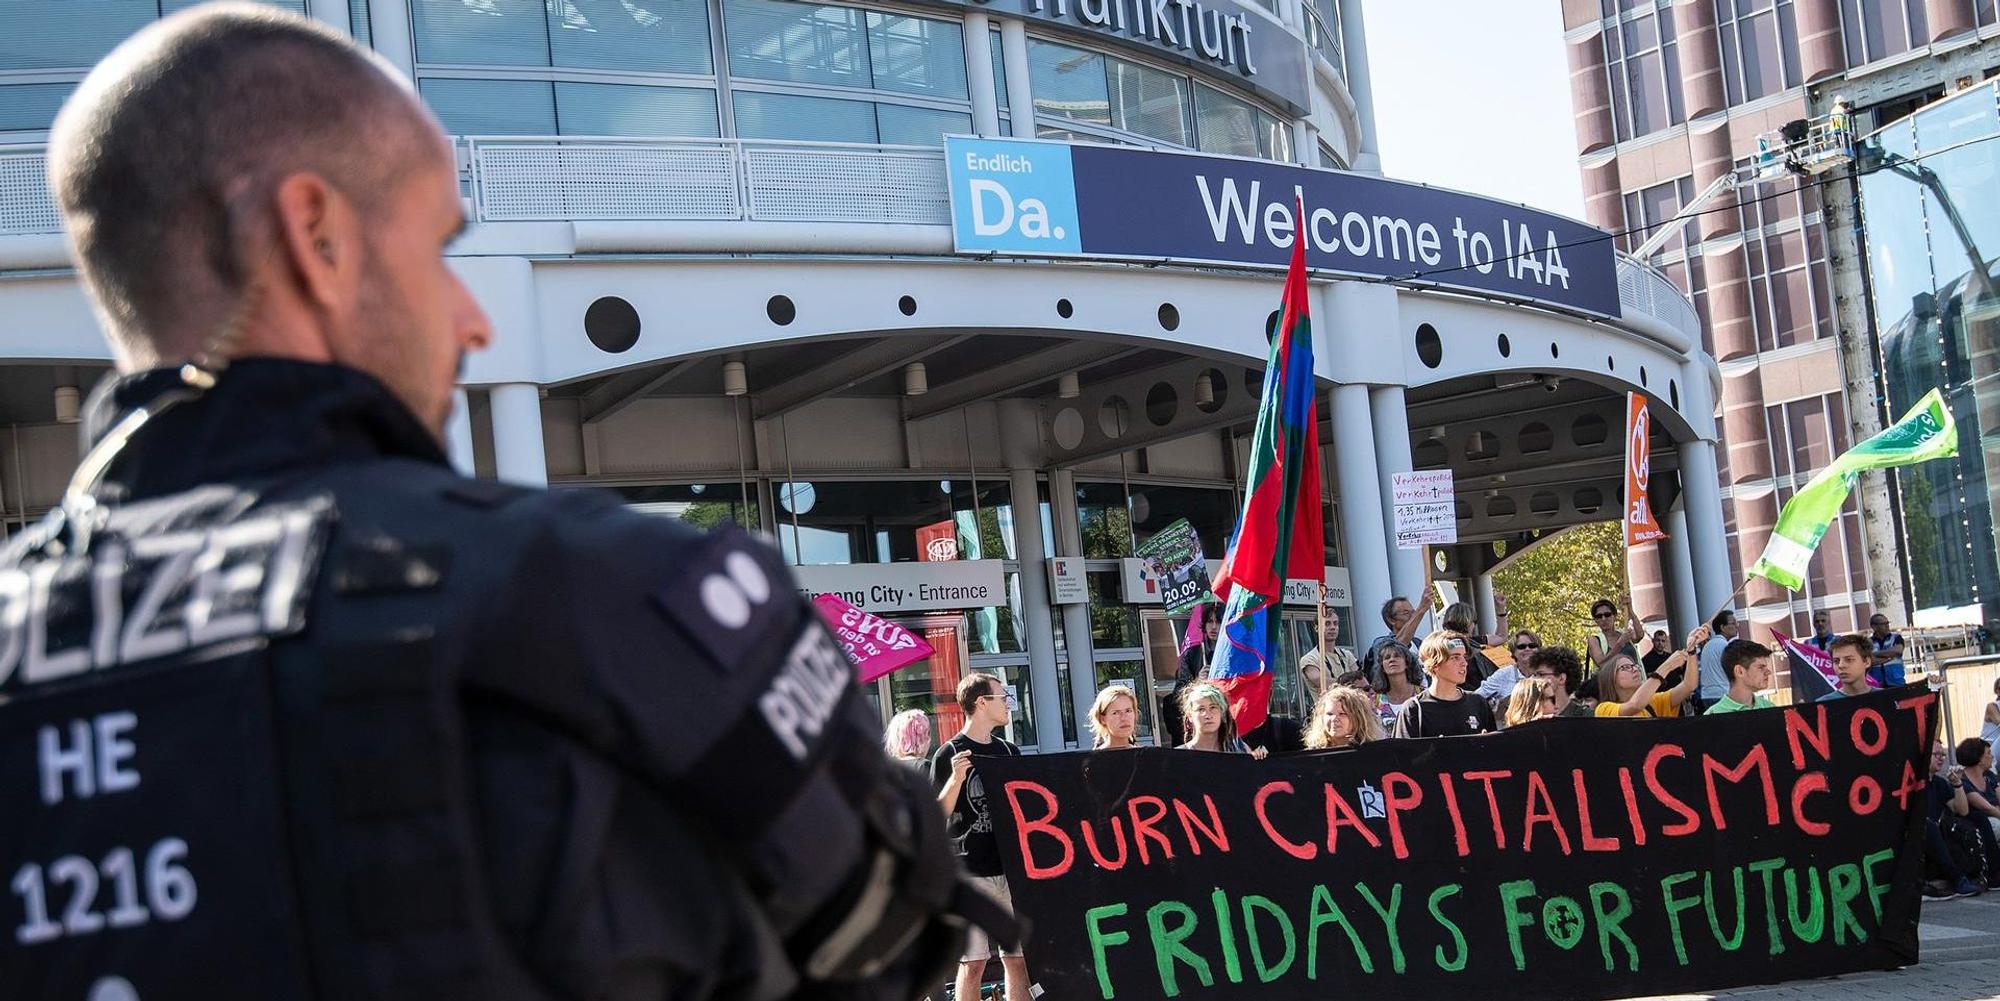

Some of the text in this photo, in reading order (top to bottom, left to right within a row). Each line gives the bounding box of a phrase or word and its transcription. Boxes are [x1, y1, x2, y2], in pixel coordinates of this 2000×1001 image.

[966, 152, 1032, 174] Endlich
[969, 178, 1066, 240] Da.
[1195, 175, 1570, 290] Welcome to IAA
[870, 585, 904, 606] City
[919, 583, 988, 601] Entrance
[1164, 580, 1201, 604] 20.09.
[1296, 582, 1311, 600] City
[38, 711, 141, 804] HE
[1784, 693, 1937, 770] NOT
[1253, 742, 1780, 860] CAPITALISM
[10, 836, 198, 943] 1216
[1085, 881, 1468, 1000] FRIDAYS
[1499, 878, 1640, 972] FOR
